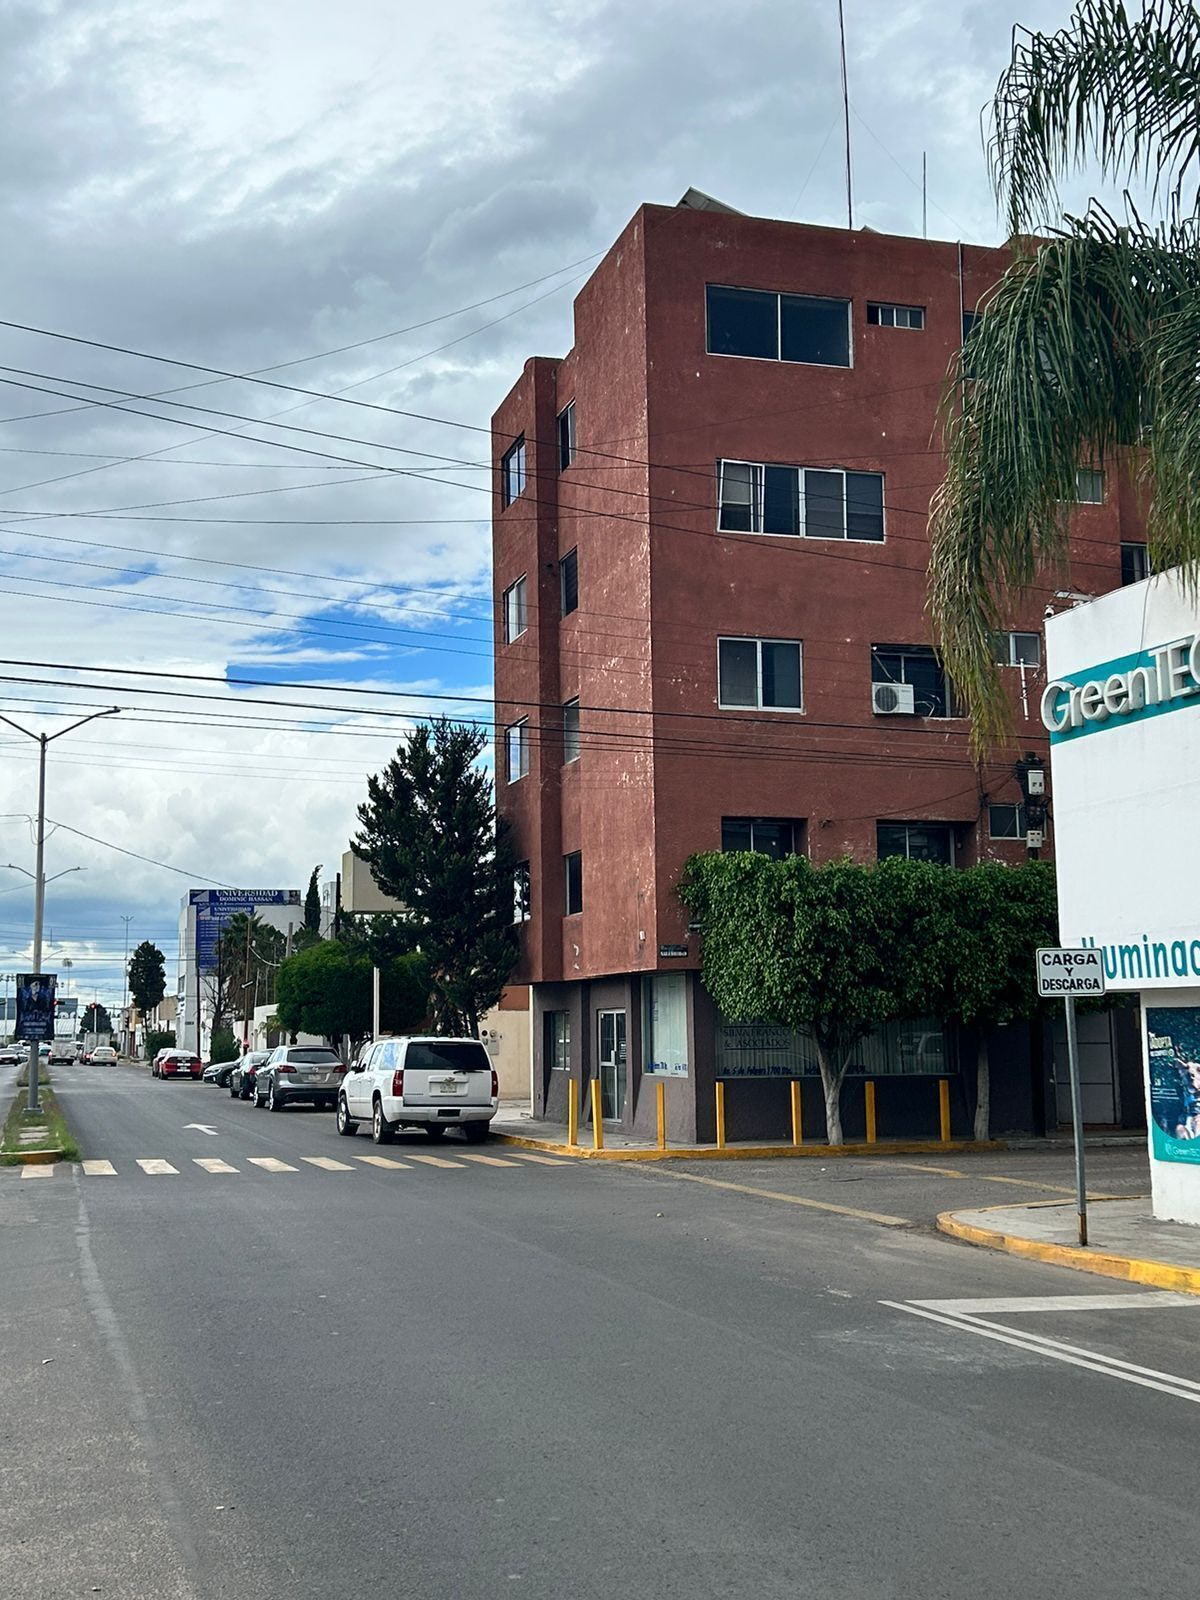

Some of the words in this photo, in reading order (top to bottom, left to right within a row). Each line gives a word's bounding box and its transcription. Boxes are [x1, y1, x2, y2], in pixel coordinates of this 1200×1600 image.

[216, 889, 278, 897] UNIVERSIDAD
[1041, 953, 1098, 966] CARGA
[1064, 967, 1074, 977] Y
[1042, 978, 1100, 990] DESCARGA
[751, 1027, 791, 1037] FRANCO
[736, 1039, 791, 1048] ASOCIADOS
